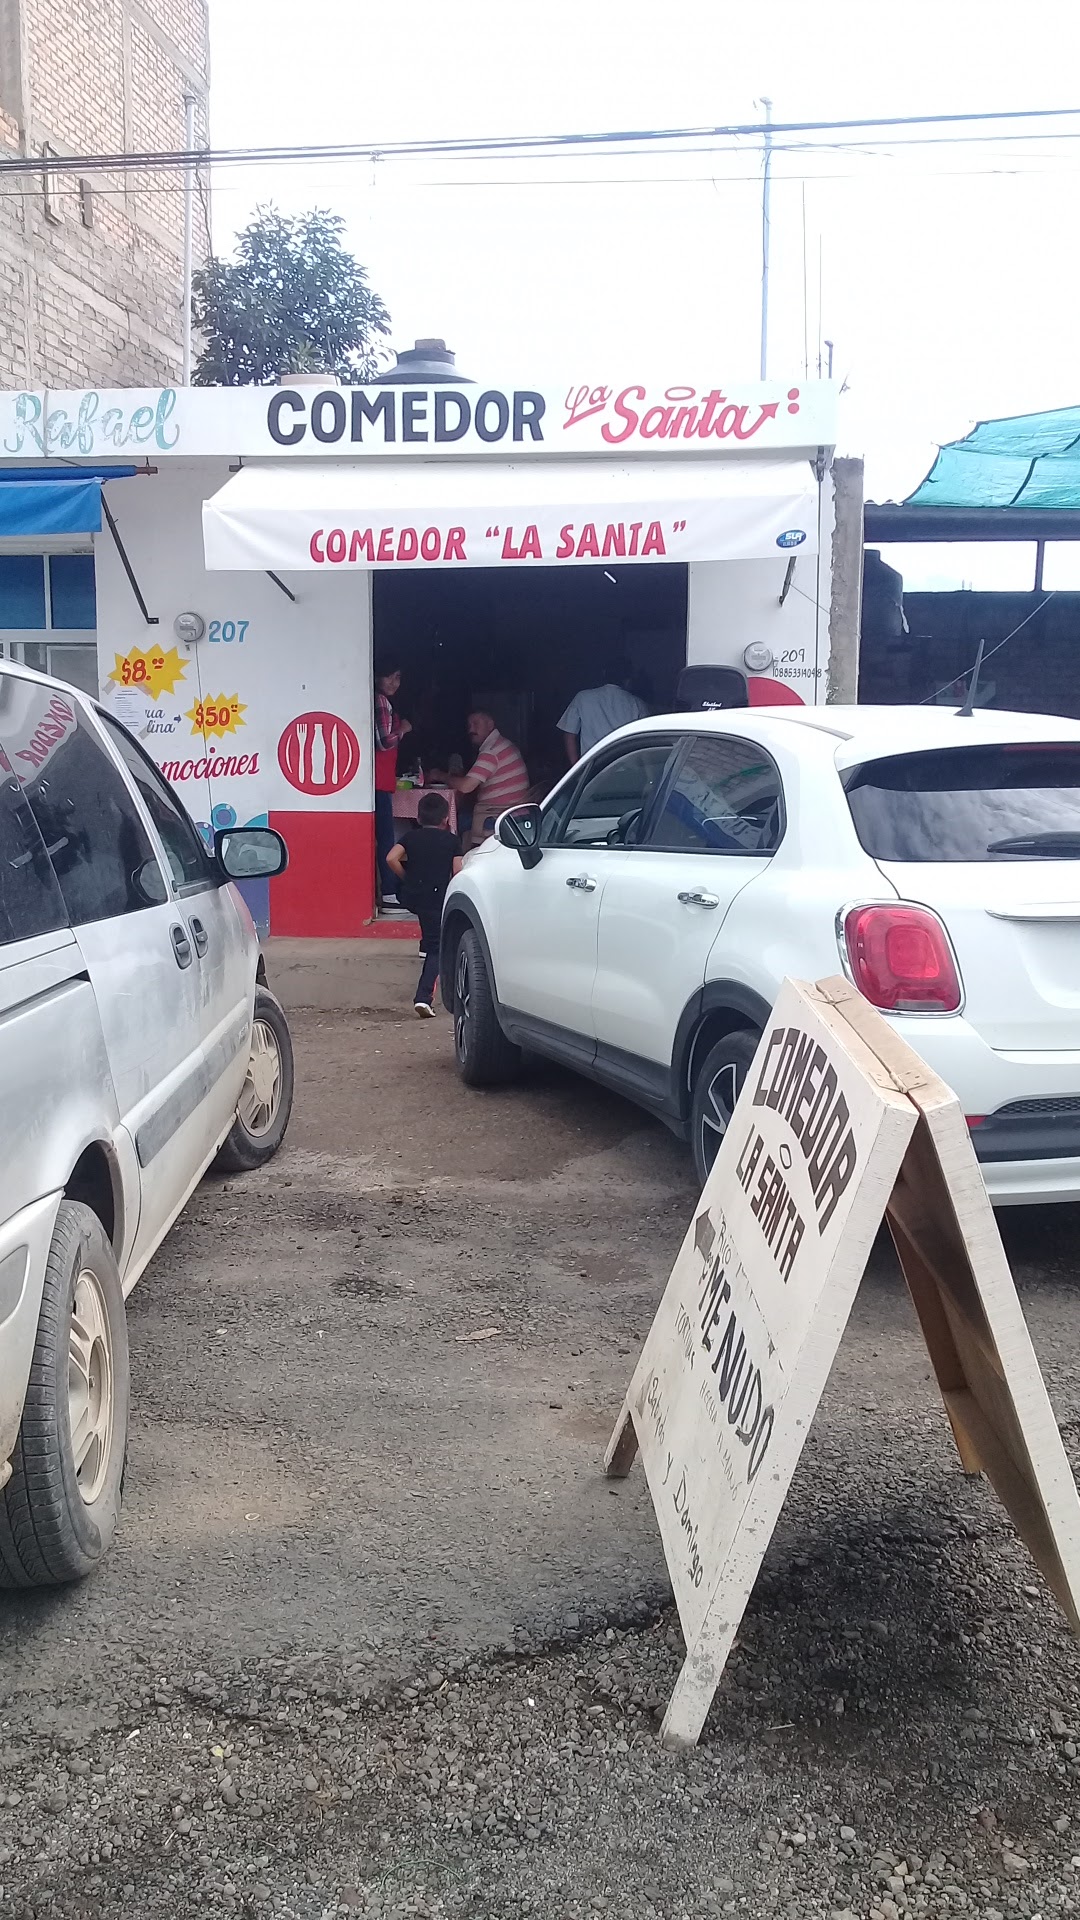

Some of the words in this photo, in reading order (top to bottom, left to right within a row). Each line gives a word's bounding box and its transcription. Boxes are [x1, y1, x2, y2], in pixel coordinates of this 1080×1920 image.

[4, 388, 180, 454] Rafael
[267, 390, 547, 446] COMEDOR
[601, 385, 779, 444] Santa
[309, 527, 467, 562] COMEDOR
[208, 620, 250, 642] 207
[780, 648, 805, 662] 209
[752, 1028, 857, 1237] COMEDOR
[735, 1123, 764, 1194] LA
[750, 1154, 805, 1284] SANTA
